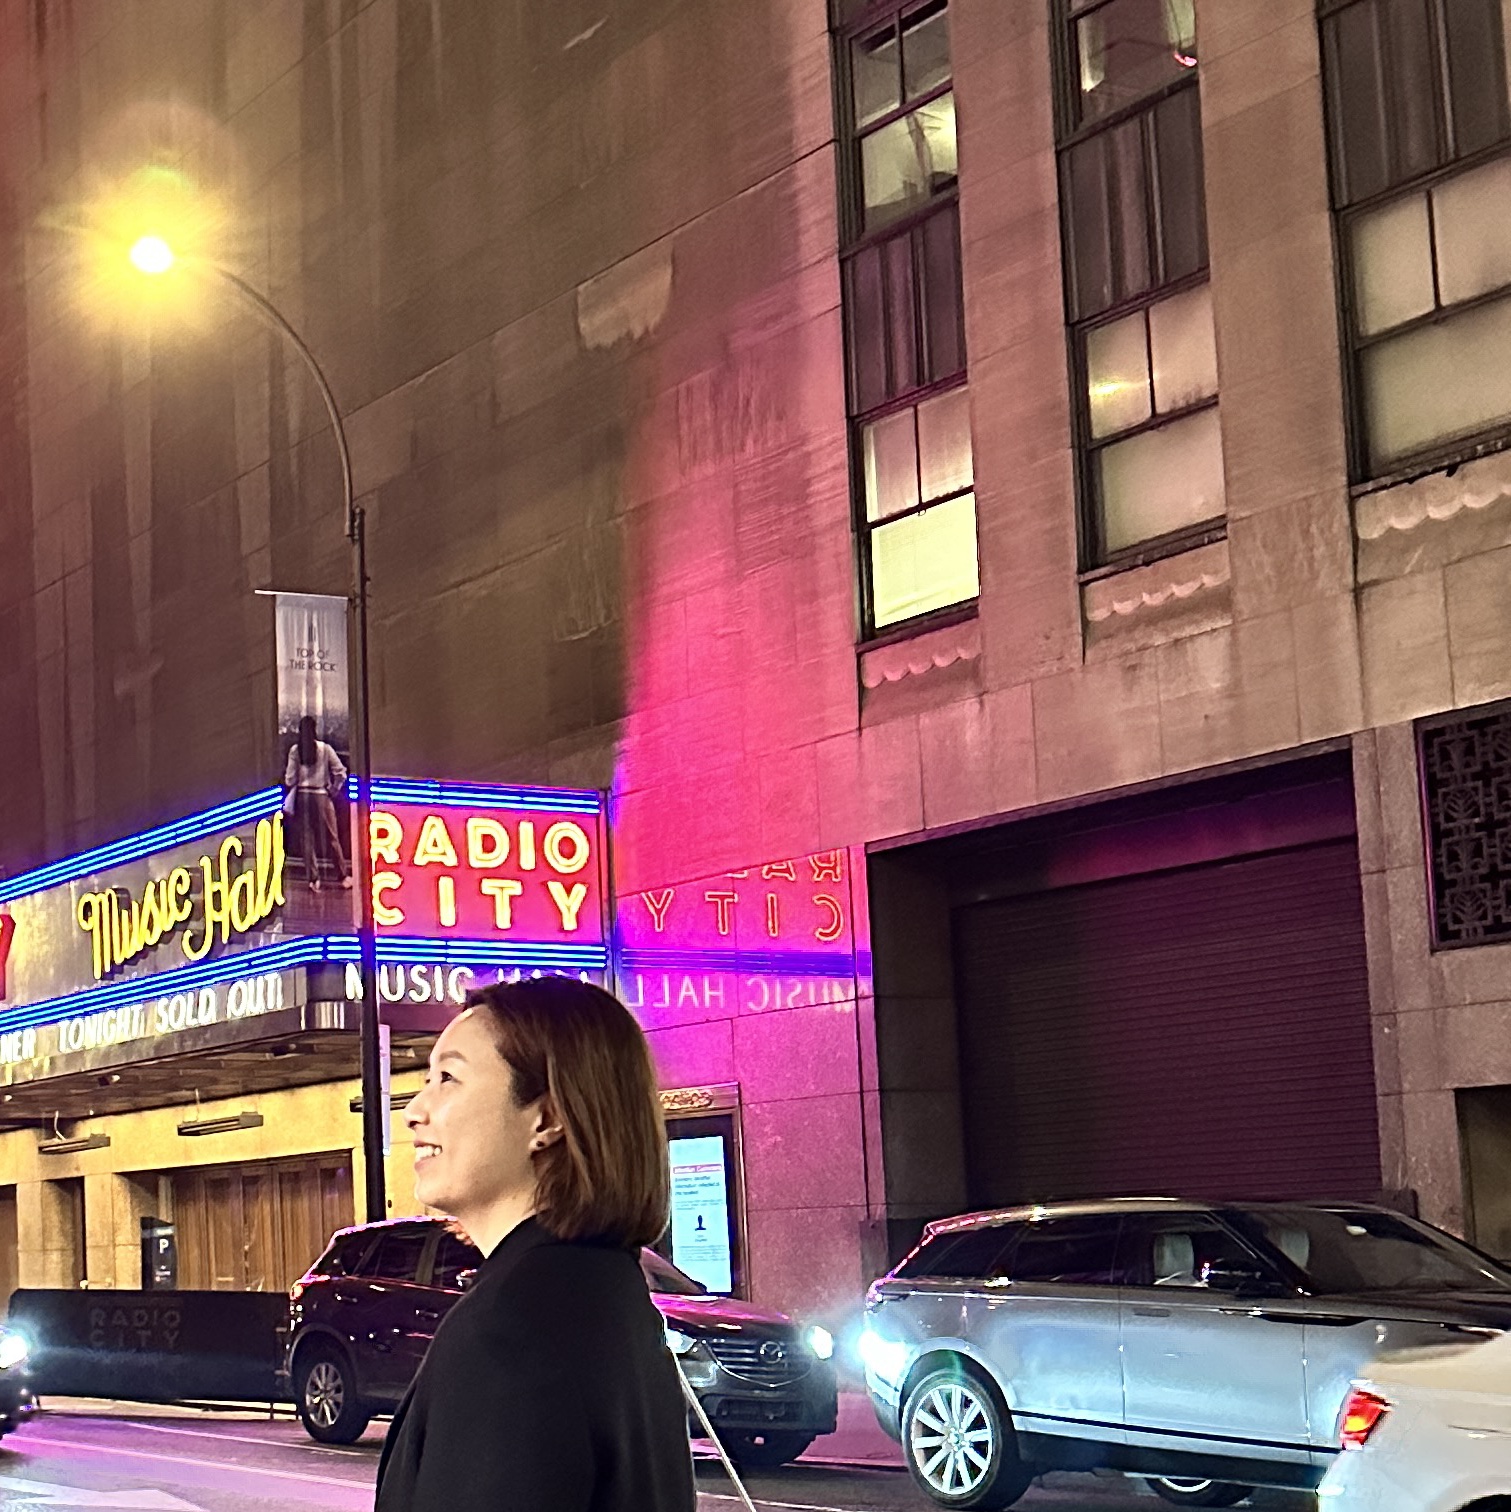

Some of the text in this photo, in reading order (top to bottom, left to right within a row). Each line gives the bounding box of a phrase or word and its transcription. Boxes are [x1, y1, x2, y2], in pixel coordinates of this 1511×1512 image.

[290, 658, 337, 673] THE ROCK
[296, 647, 314, 658] TOP
[370, 812, 591, 873] RADIO
[77, 812, 285, 980] Music Hall
[372, 870, 588, 931] CITY
[345, 962, 474, 1004] MUSIC
[155, 987, 217, 1034] SOLD
[159, 1238, 169, 1254] P
[90, 1307, 181, 1328] RADIO
[90, 1329, 180, 1350] CITY
